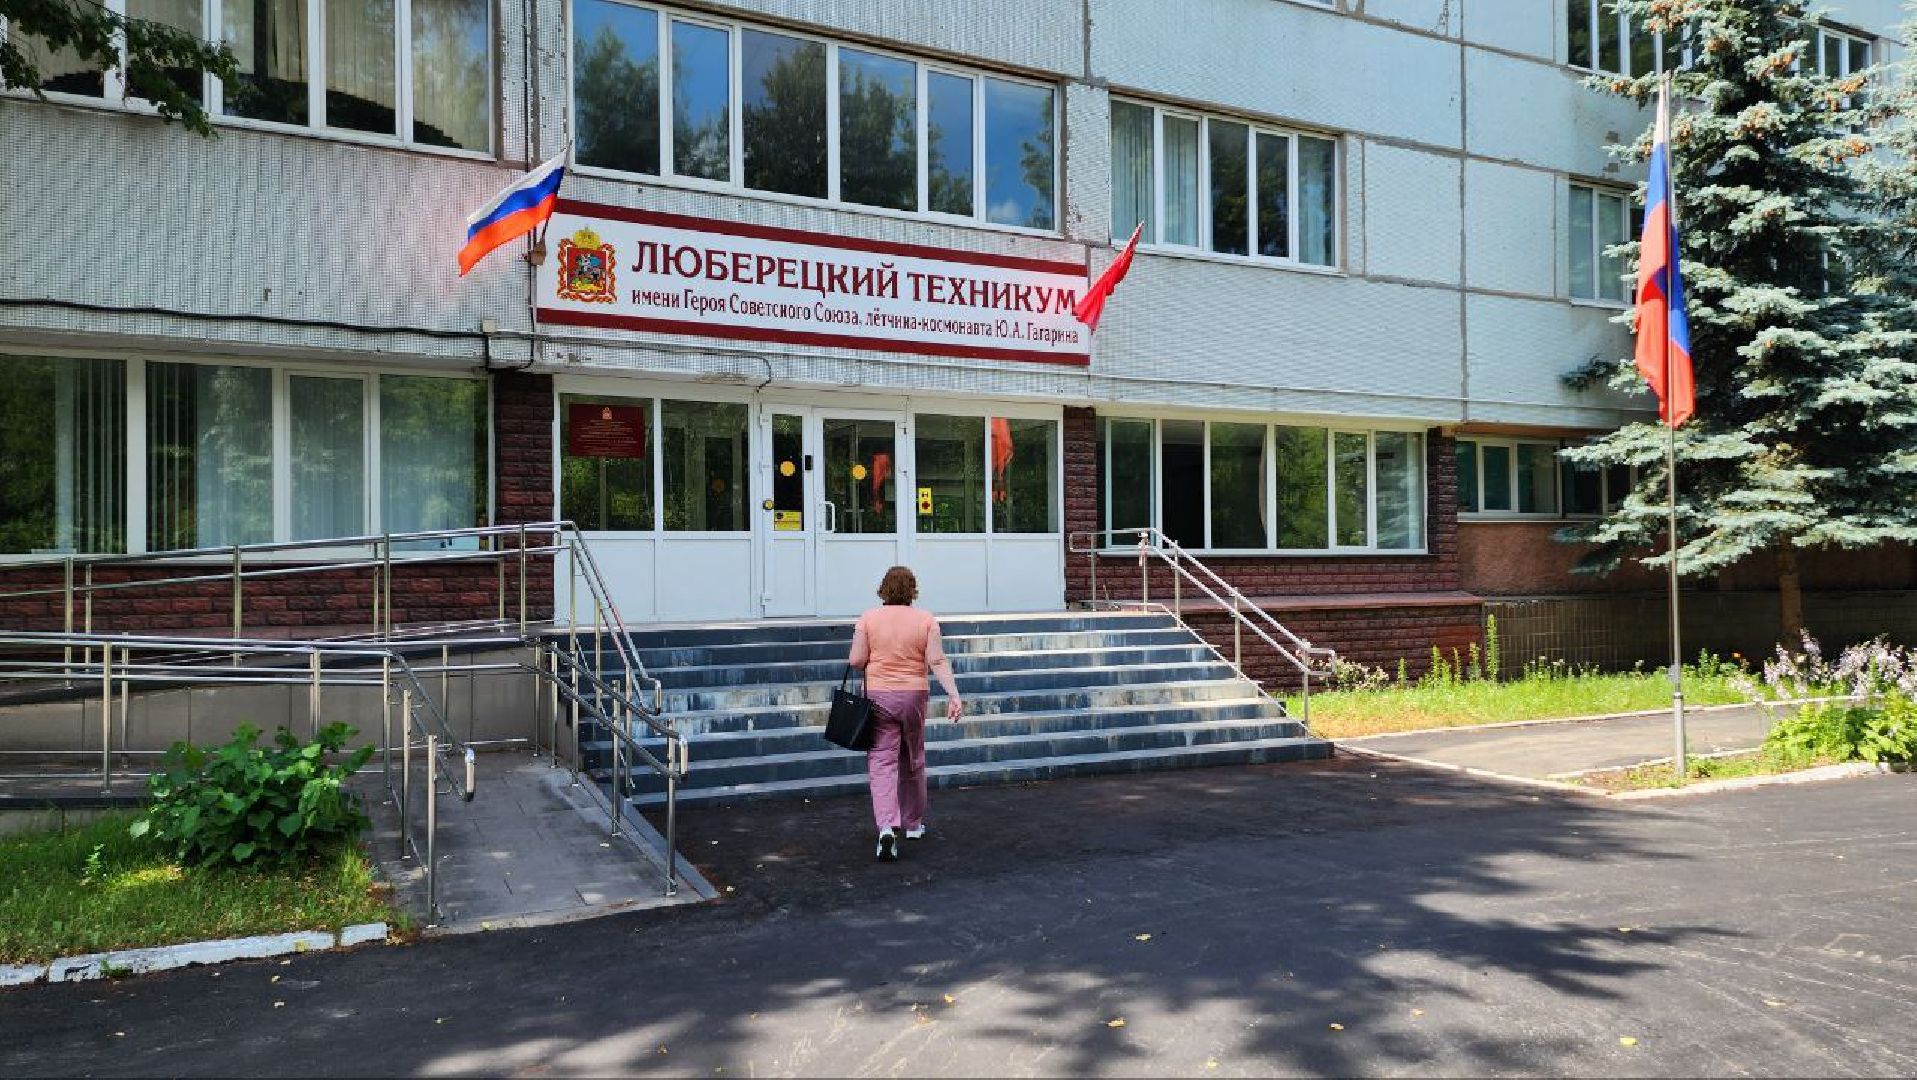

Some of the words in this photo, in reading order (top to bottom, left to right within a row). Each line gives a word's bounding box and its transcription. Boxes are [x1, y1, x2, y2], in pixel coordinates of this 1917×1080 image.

[631, 240, 899, 299] ЛЮБЕРЕЦКИЙ
[906, 271, 1080, 317] ТЕХНИКУМ
[632, 289, 680, 309] имени
[684, 288, 726, 317] Героя
[729, 293, 811, 320] Советского
[814, 301, 862, 326] Союза,
[866, 307, 992, 336] лётчика-космонавта
[996, 319, 1025, 340] Ю.А.
[1027, 322, 1079, 347] Гагарина
